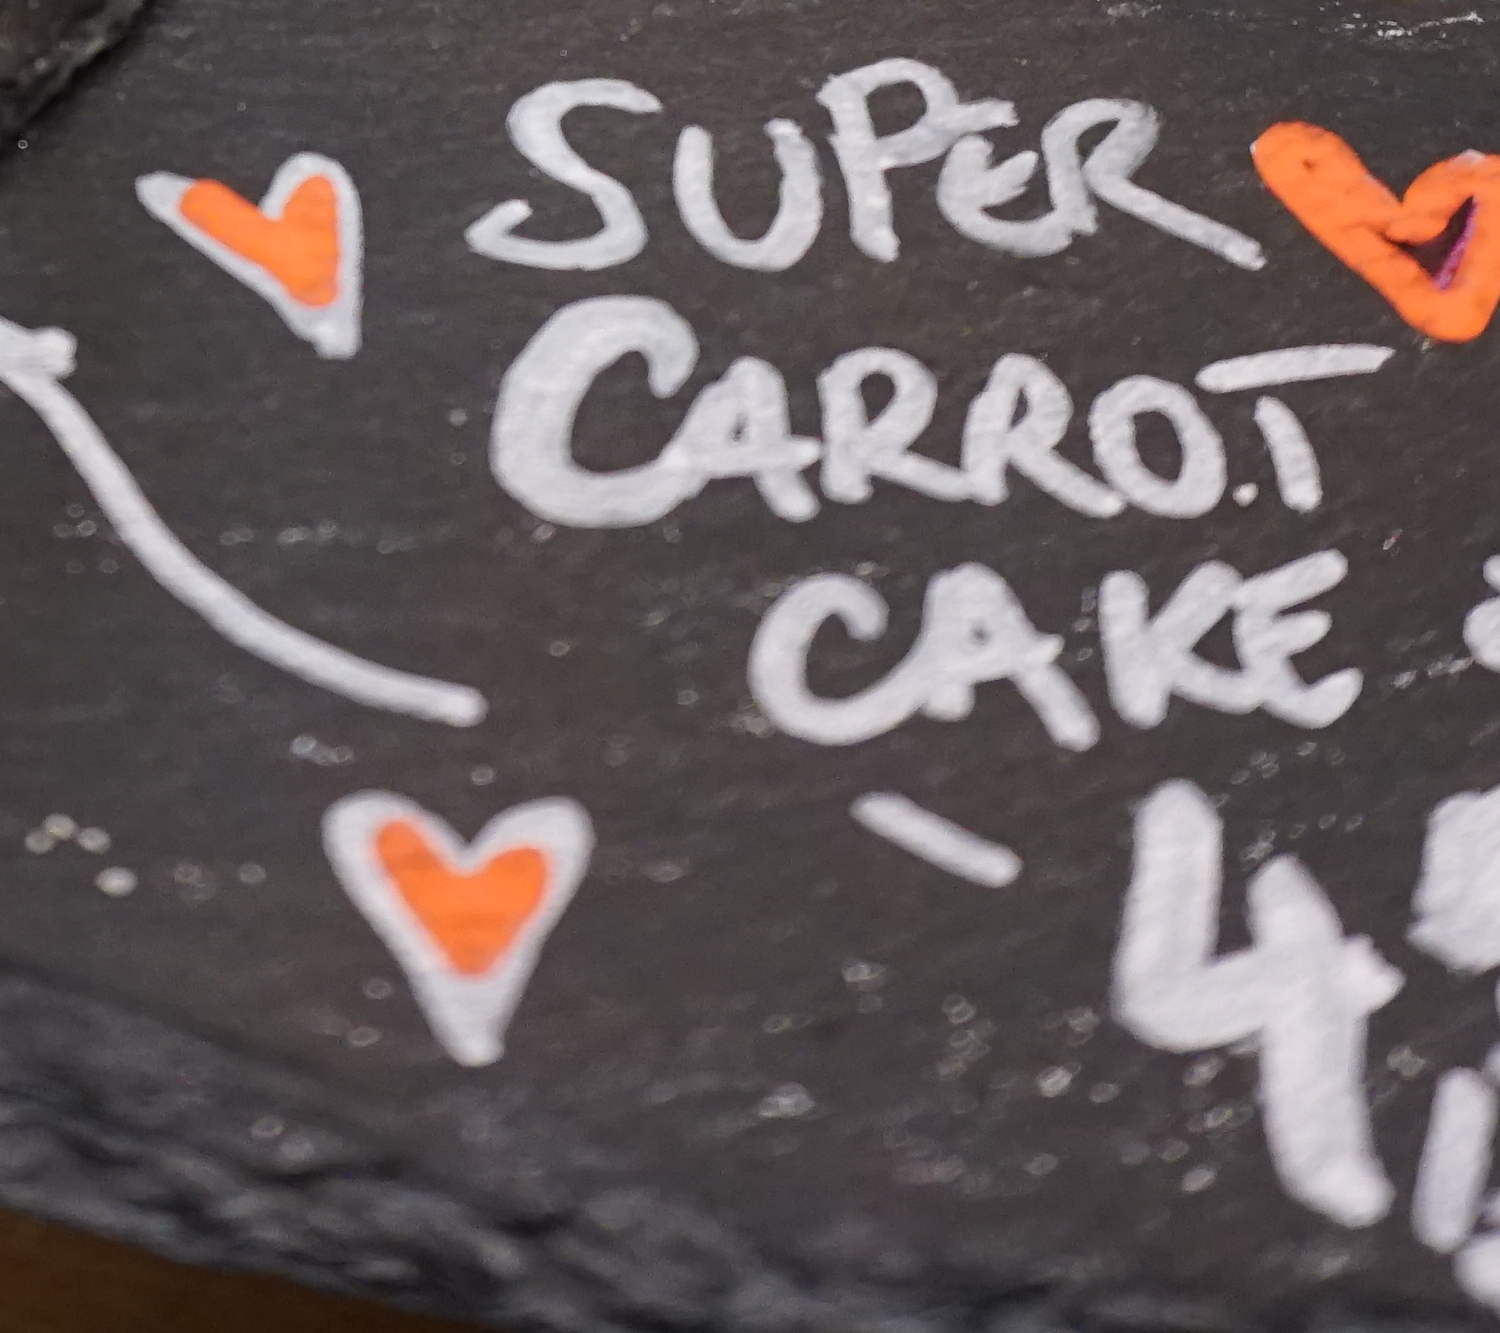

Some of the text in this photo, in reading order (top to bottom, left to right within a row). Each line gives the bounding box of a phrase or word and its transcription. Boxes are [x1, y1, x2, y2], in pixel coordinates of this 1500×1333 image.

[465, 55, 1267, 273] SUPER
[488, 293, 1396, 529] CARROT
[747, 548, 1365, 750] CAKE
